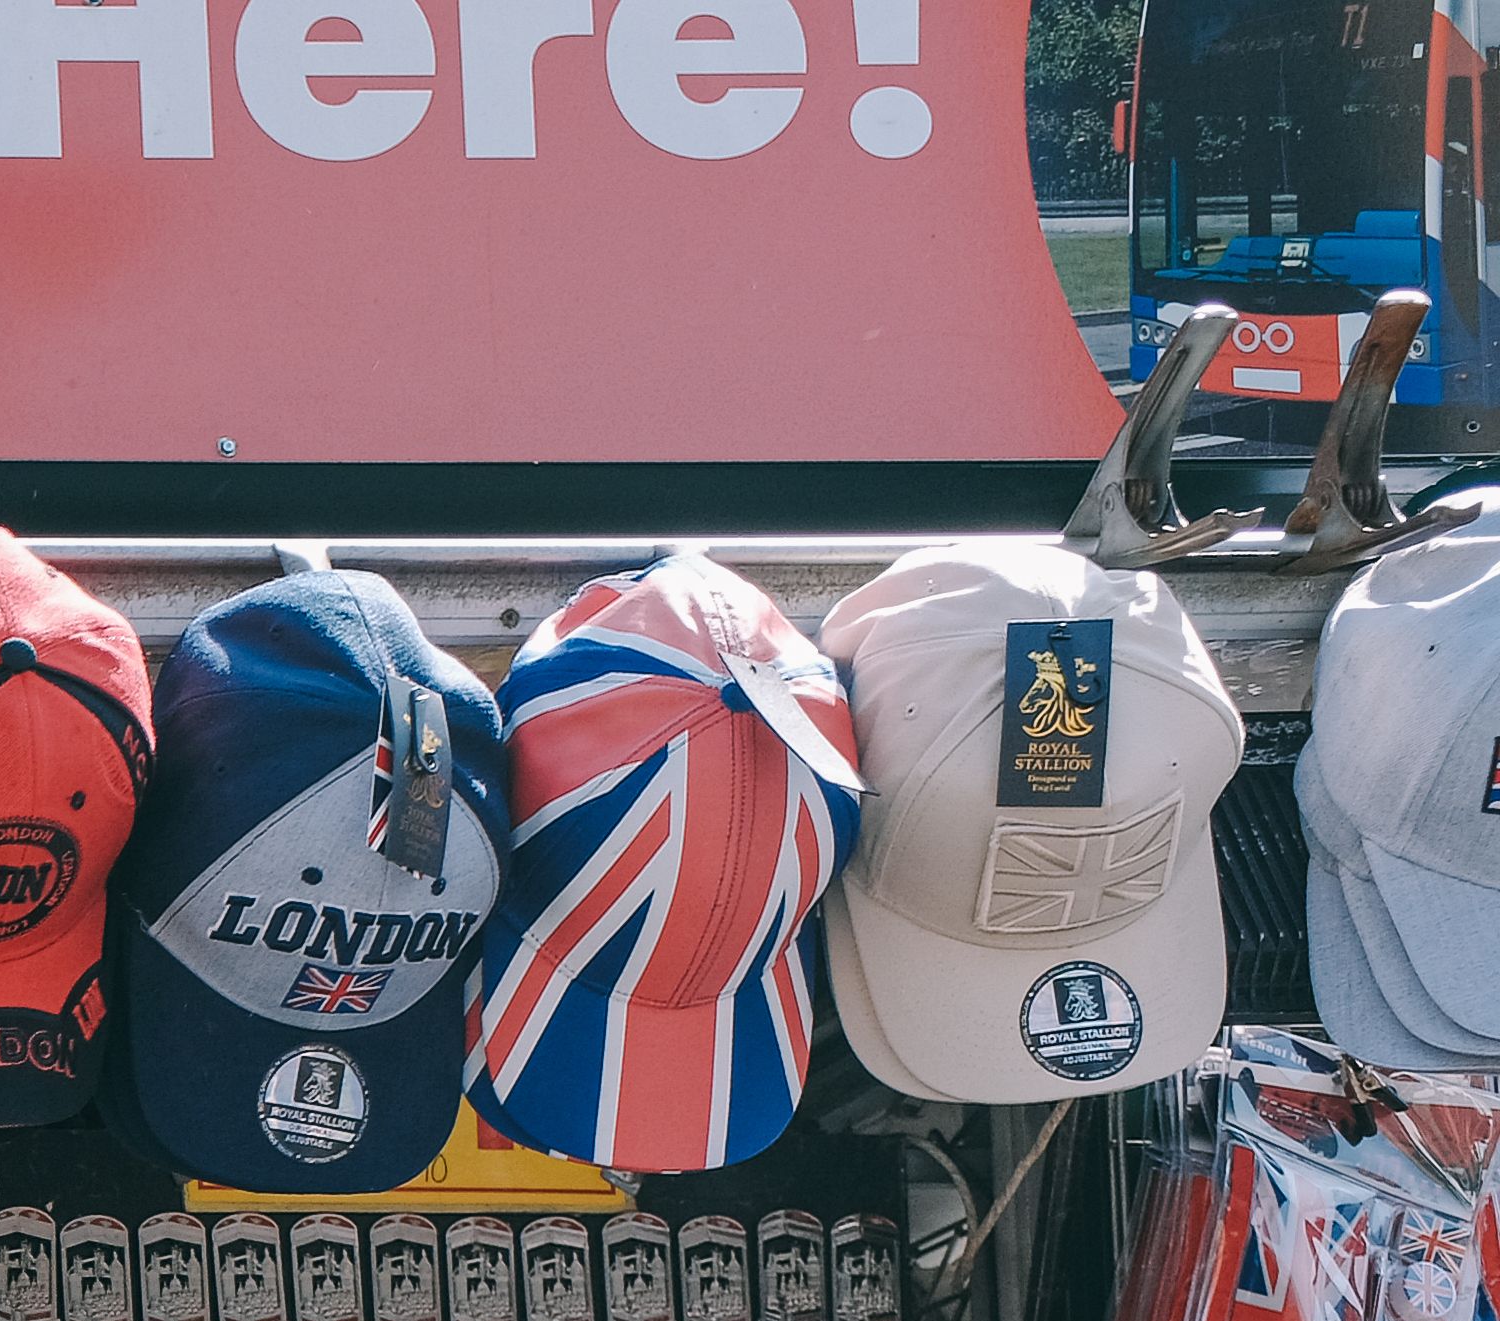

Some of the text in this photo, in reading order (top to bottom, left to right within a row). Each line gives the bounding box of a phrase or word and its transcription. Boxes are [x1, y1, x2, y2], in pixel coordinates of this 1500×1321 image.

[1028, 742, 1081, 755] ROYAL
[1014, 759, 1092, 771] STALLION
[210, 895, 479, 966] LONDON
[1040, 1026, 1130, 1045] ROYAL STALLION
[271, 1106, 356, 1131] ROYAL STALLION
